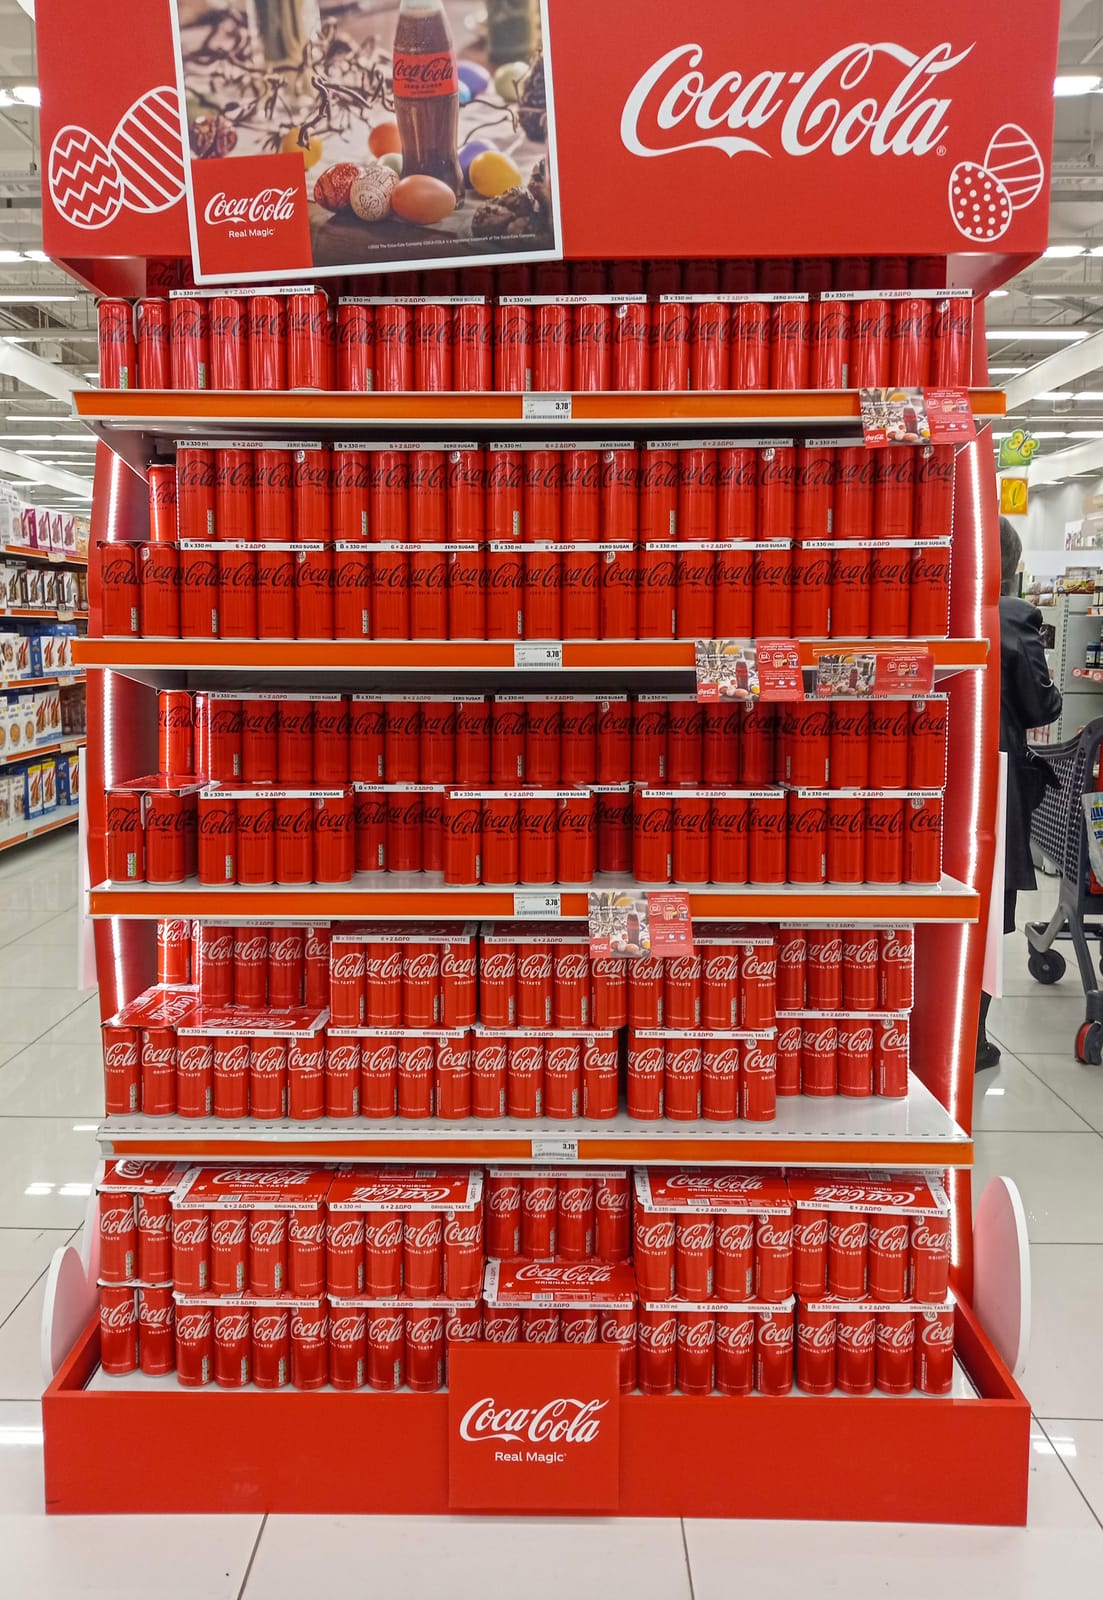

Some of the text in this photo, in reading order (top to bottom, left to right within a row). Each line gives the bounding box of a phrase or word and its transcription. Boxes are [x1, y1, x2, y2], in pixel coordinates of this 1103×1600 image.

[393, 57, 454, 82] Coca-Cola
[620, 42, 976, 158] Coca-Cola
[205, 187, 299, 225] Coca-Cola
[228, 227, 274, 238] Real Magic
[212, 1169, 317, 1185] Coca-Cola
[666, 1174, 765, 1189] Coca-Cola
[515, 1264, 615, 1282] Coca-Cola
[459, 1397, 610, 1443] Coca-Cola
[495, 1451, 565, 1464] Real Magic
